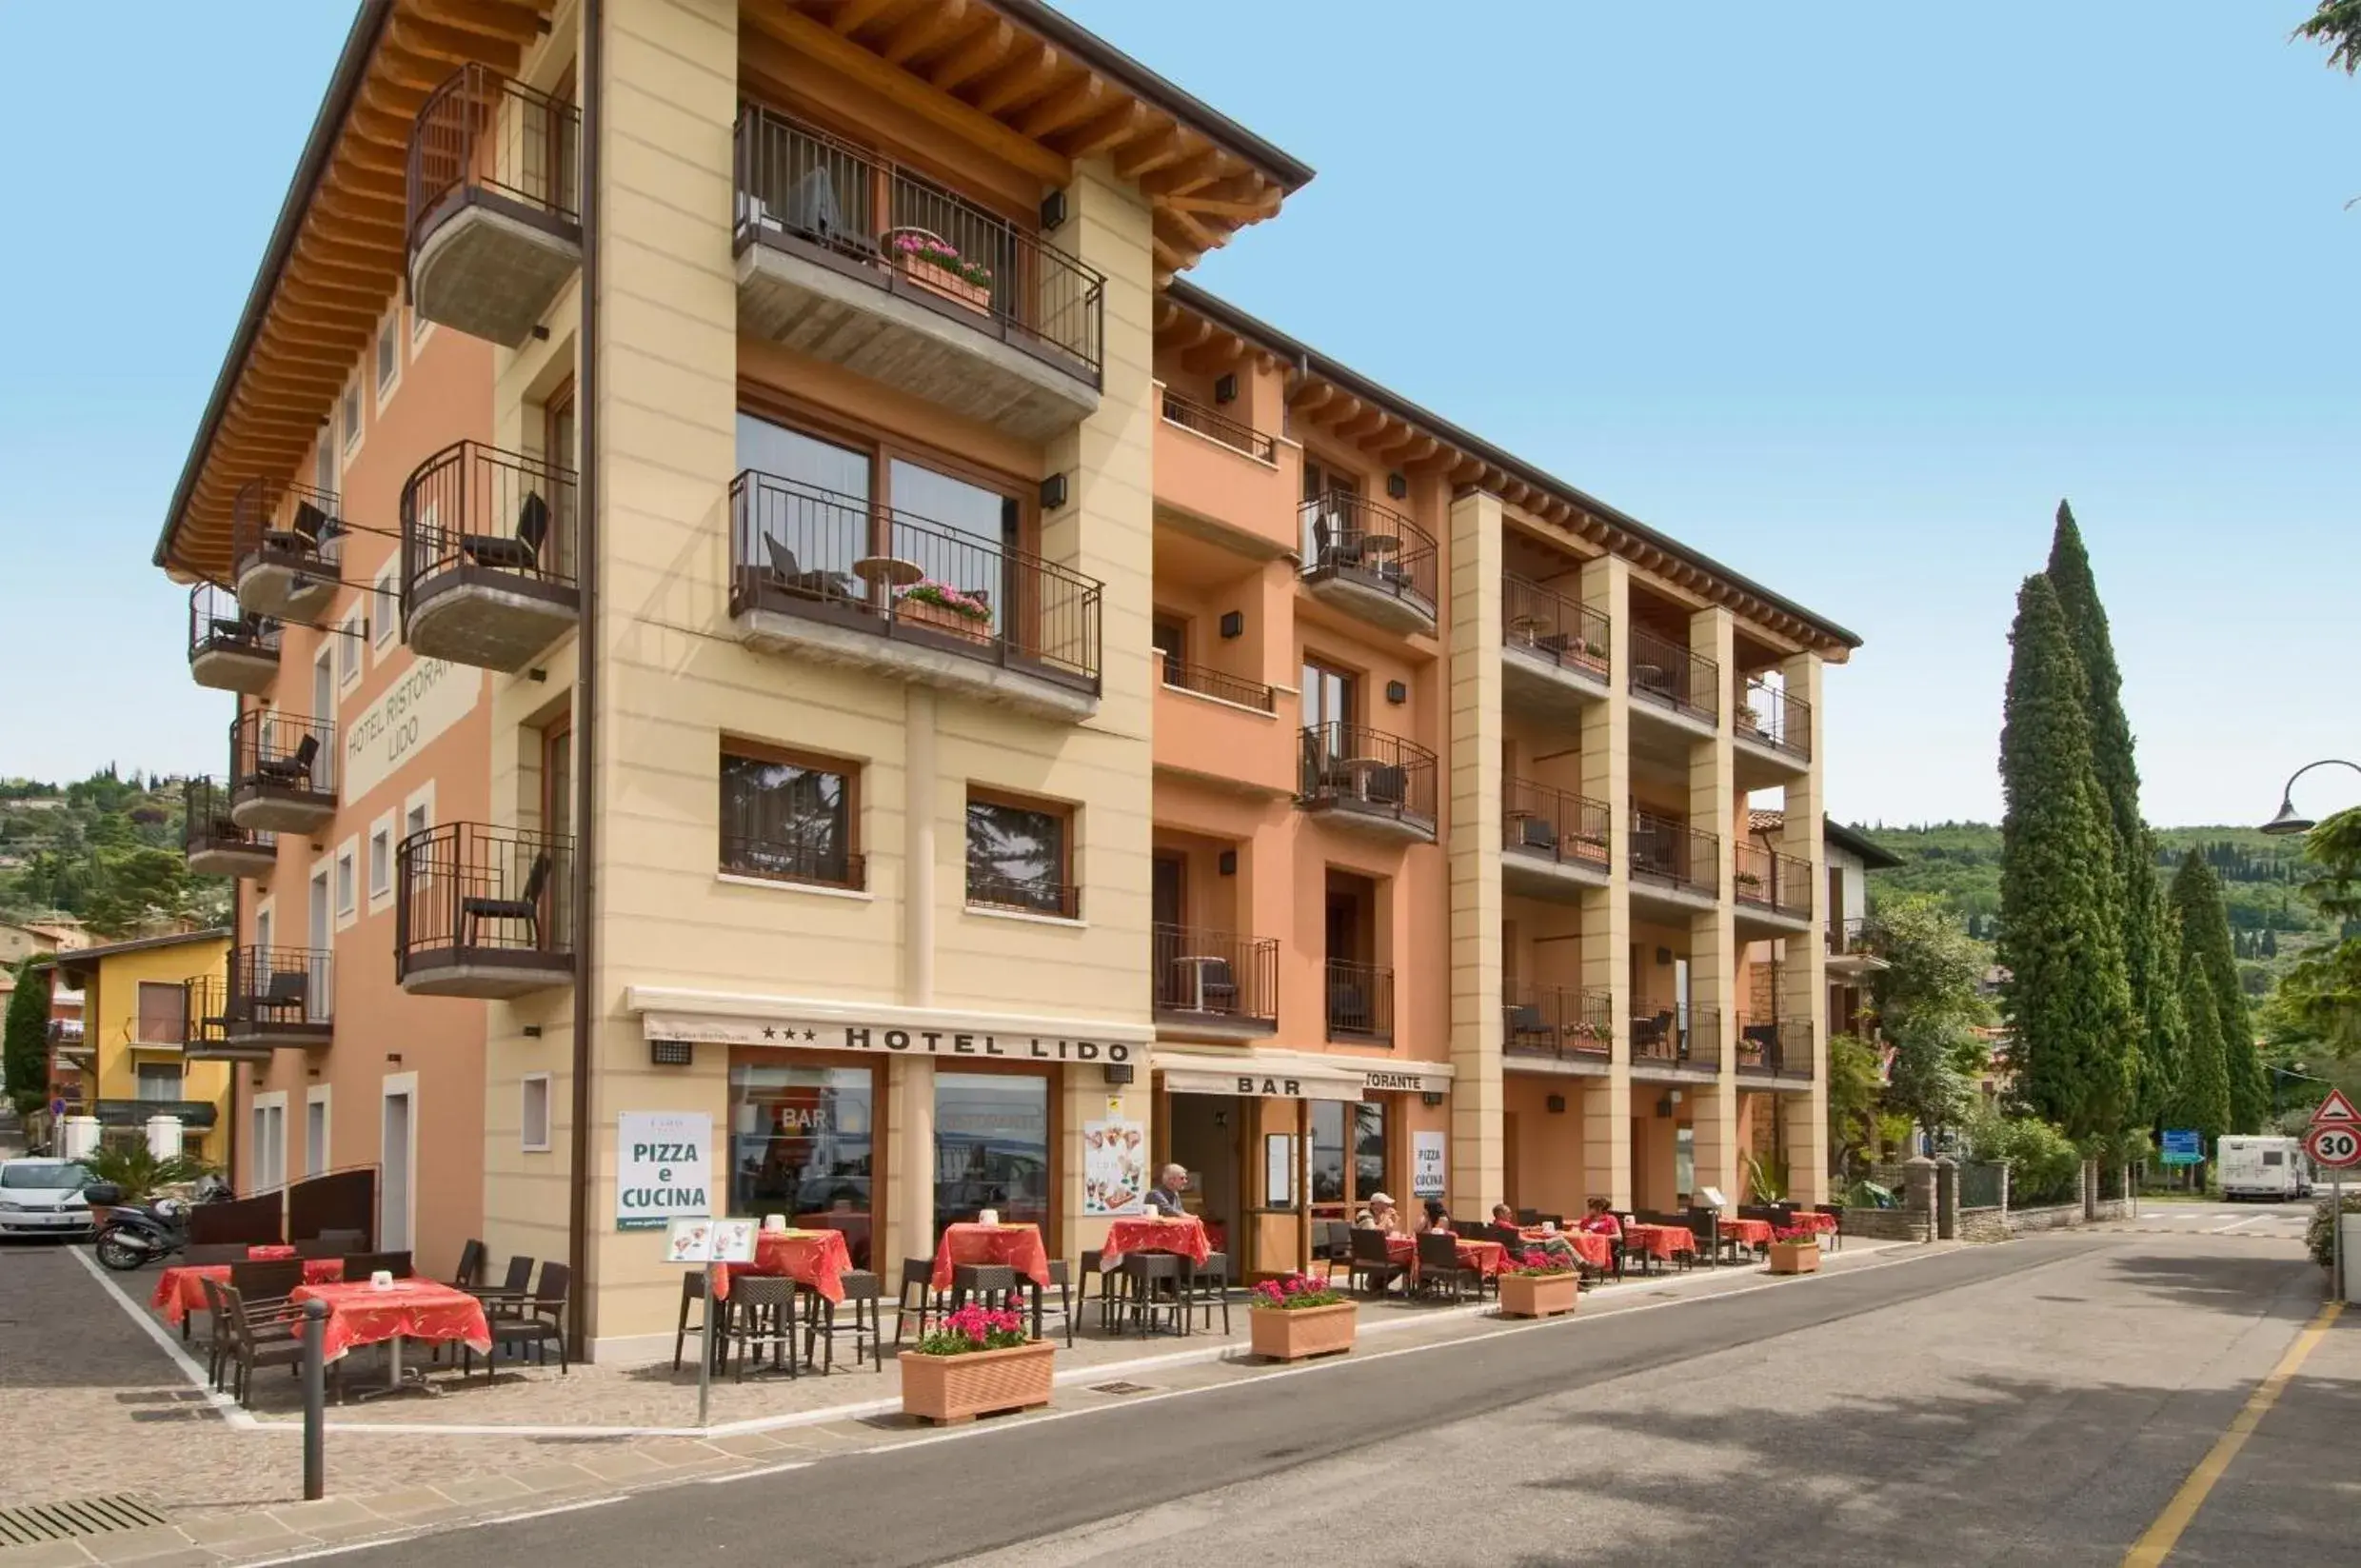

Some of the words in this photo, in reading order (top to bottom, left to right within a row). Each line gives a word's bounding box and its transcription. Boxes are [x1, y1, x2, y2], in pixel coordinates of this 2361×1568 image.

[348, 710, 385, 759] HOTEL
[388, 715, 419, 762] LIDO
[845, 1027, 1004, 1055] HOTEL
[1031, 1039, 1129, 1062] LIDO
[1238, 1077, 1300, 1095] BAR
[783, 1108, 826, 1127] BAR
[633, 1143, 699, 1162] PIZZA
[1419, 1148, 1441, 1161] PIZZA
[2320, 1136, 2353, 1156] 30
[658, 1167, 672, 1181] e
[622, 1187, 706, 1207] CUCINA
